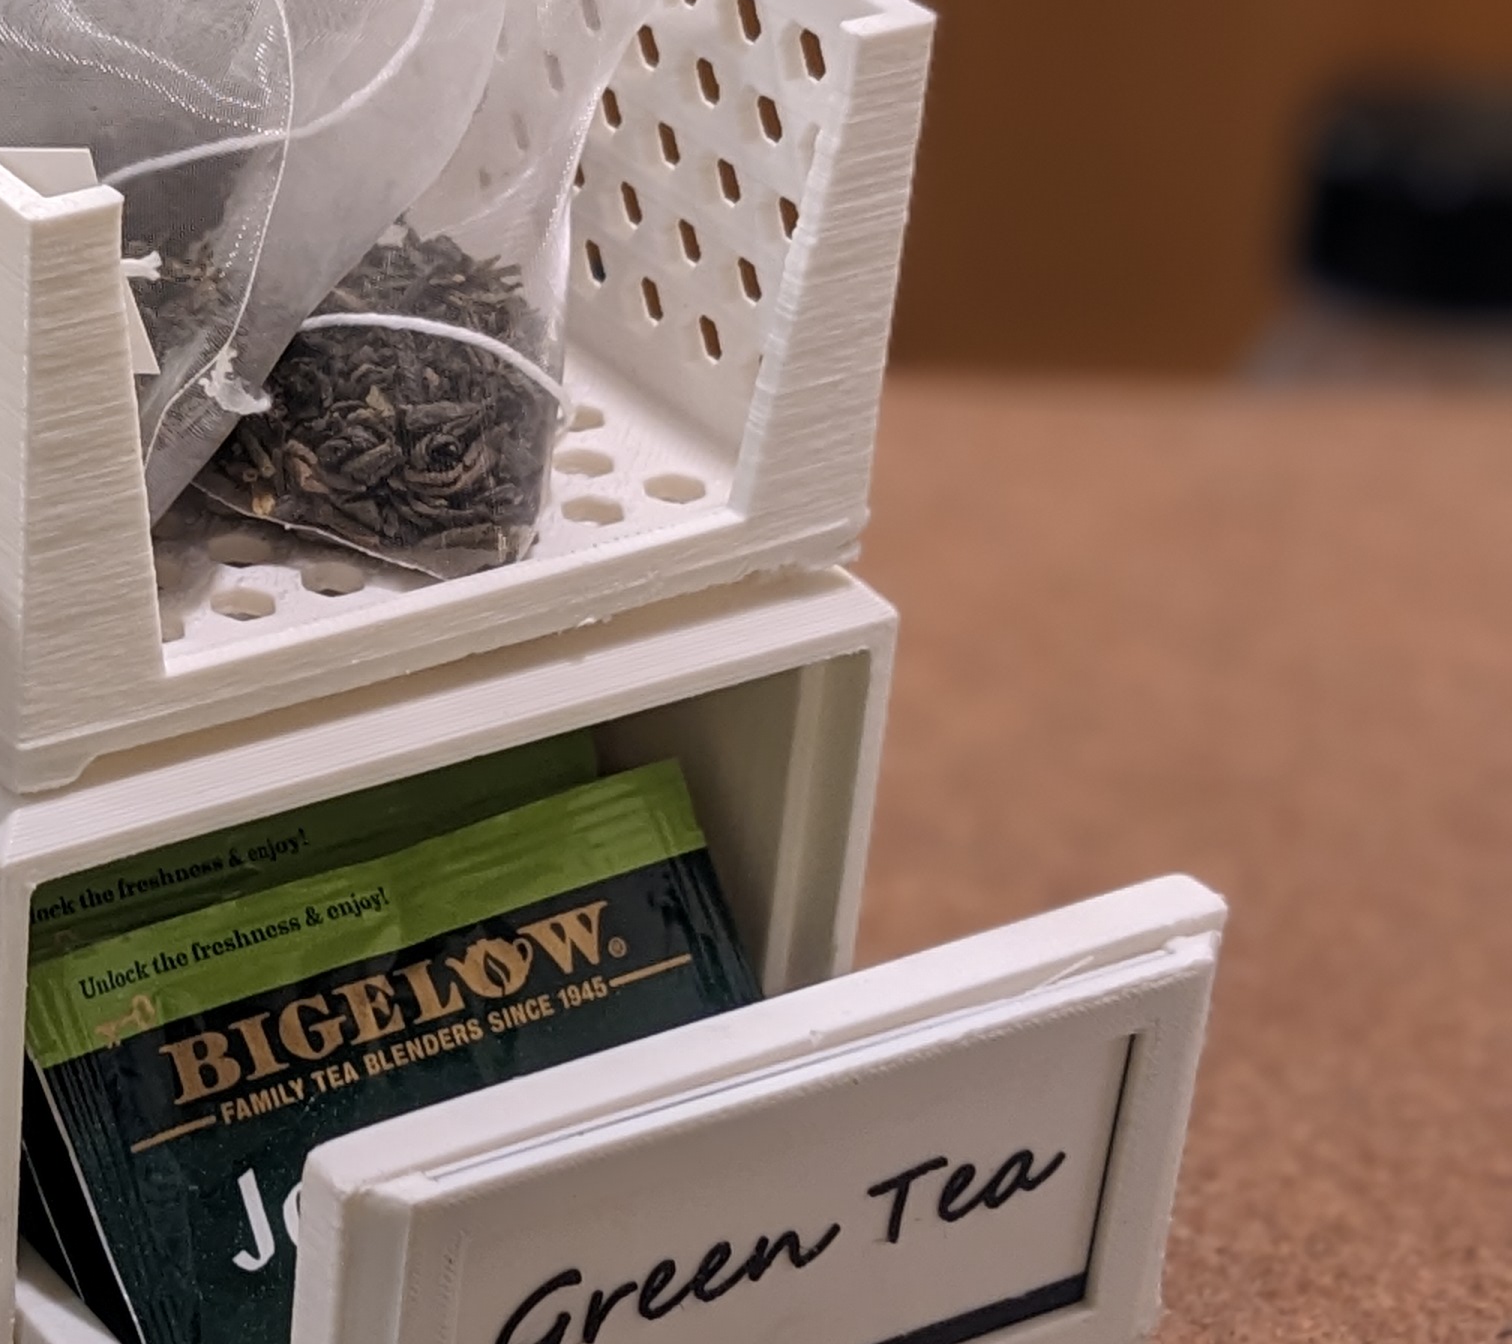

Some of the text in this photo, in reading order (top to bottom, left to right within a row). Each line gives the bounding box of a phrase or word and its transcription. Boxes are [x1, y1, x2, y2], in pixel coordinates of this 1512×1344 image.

[80, 887, 114, 909] the
[118, 858, 223, 899] freshness
[228, 848, 249, 867] &
[248, 829, 310, 863] enjoy!
[78, 887, 390, 999] Unlock the freshness & enjoy!
[221, 976, 609, 1125] FAMILY TEA BLENDERS SINCE 1945
[868, 1148, 1066, 1244] Tea
